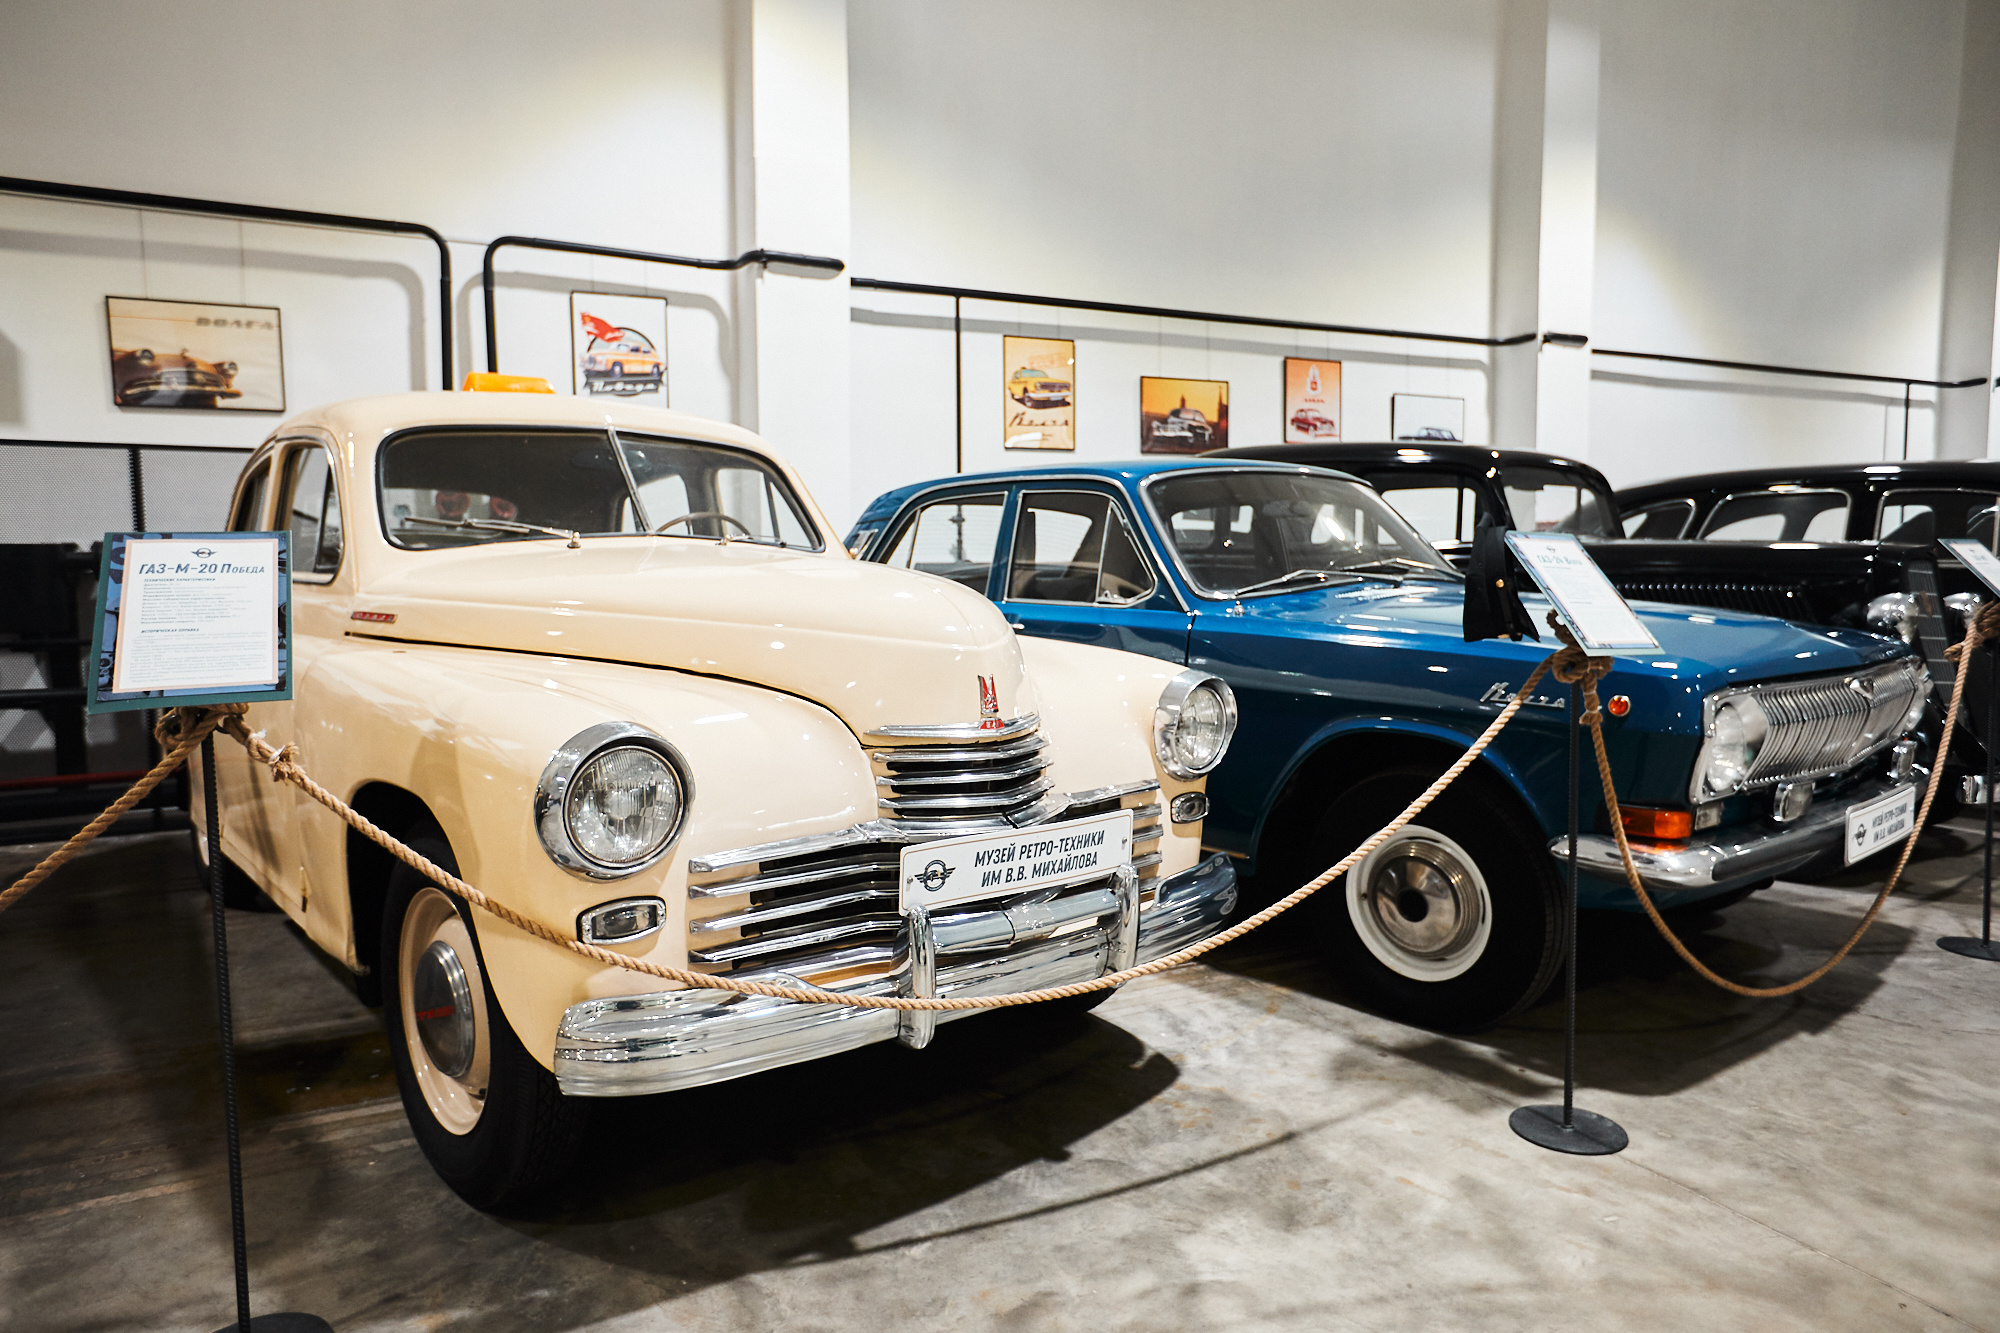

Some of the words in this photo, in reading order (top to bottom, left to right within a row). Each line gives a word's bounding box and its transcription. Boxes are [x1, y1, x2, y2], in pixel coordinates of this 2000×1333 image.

[139, 563, 218, 574] ГАЗ-М-20
[974, 843, 1015, 868] МУЗЕЙ
[1019, 830, 1105, 861] РЕТРО-ТЕХНИКИ
[981, 869, 1002, 888] ИМ
[1005, 865, 1027, 884] В.В.
[1031, 851, 1098, 879] МИХАЙЛОВА
